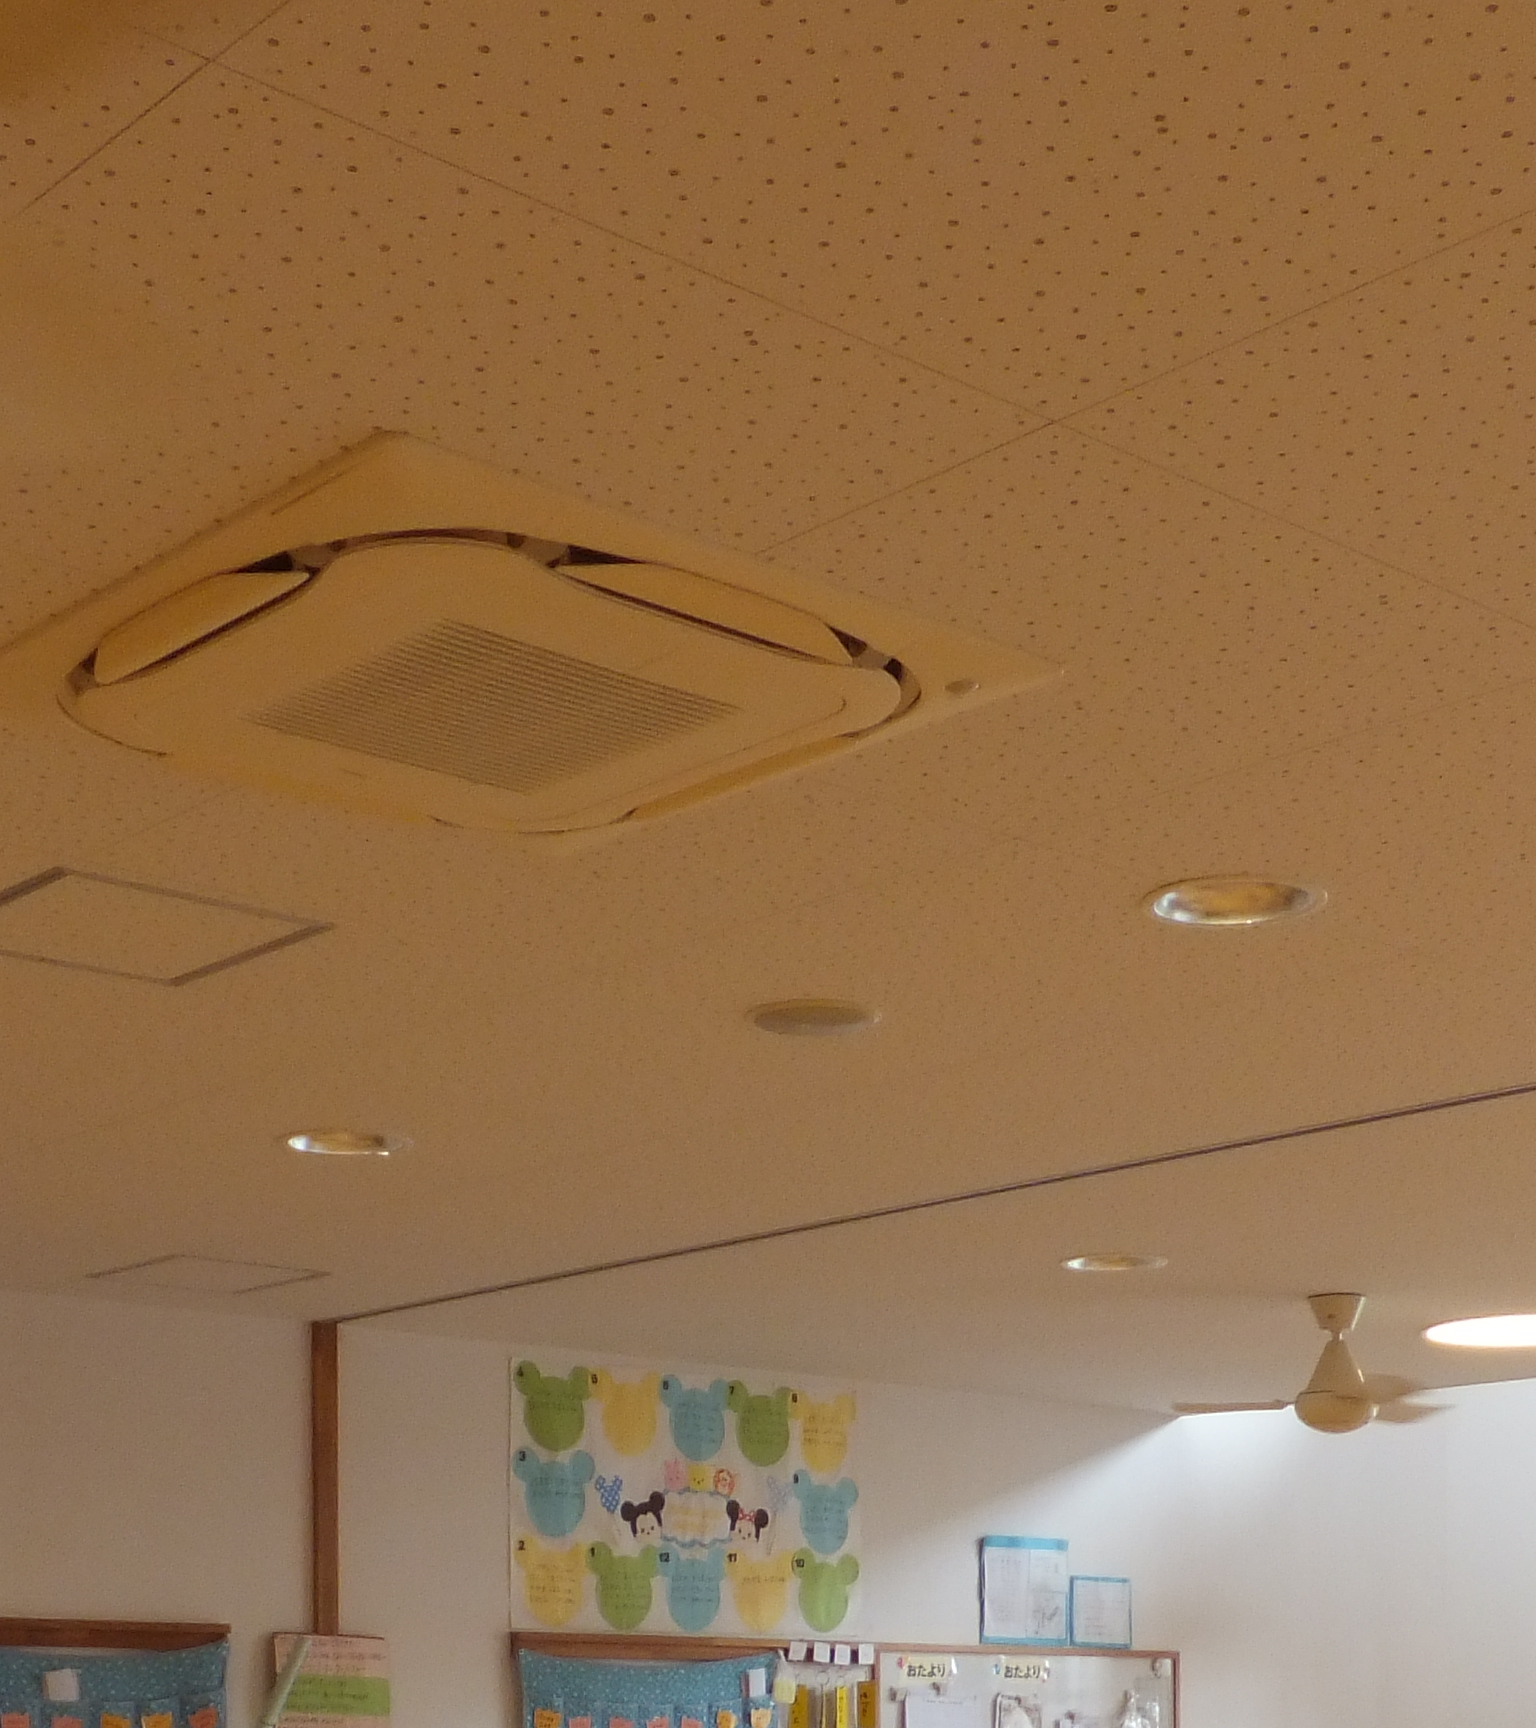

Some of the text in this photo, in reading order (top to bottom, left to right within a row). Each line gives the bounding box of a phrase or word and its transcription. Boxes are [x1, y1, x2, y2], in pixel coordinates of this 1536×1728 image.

[518, 1450, 526, 1462] 3
[518, 1540, 526, 1550] 2
[726, 1553, 737, 1562] 11
[795, 1558, 805, 1568] 10
[907, 1664, 946, 1677] おたより
[1004, 1665, 1041, 1679] おたより
